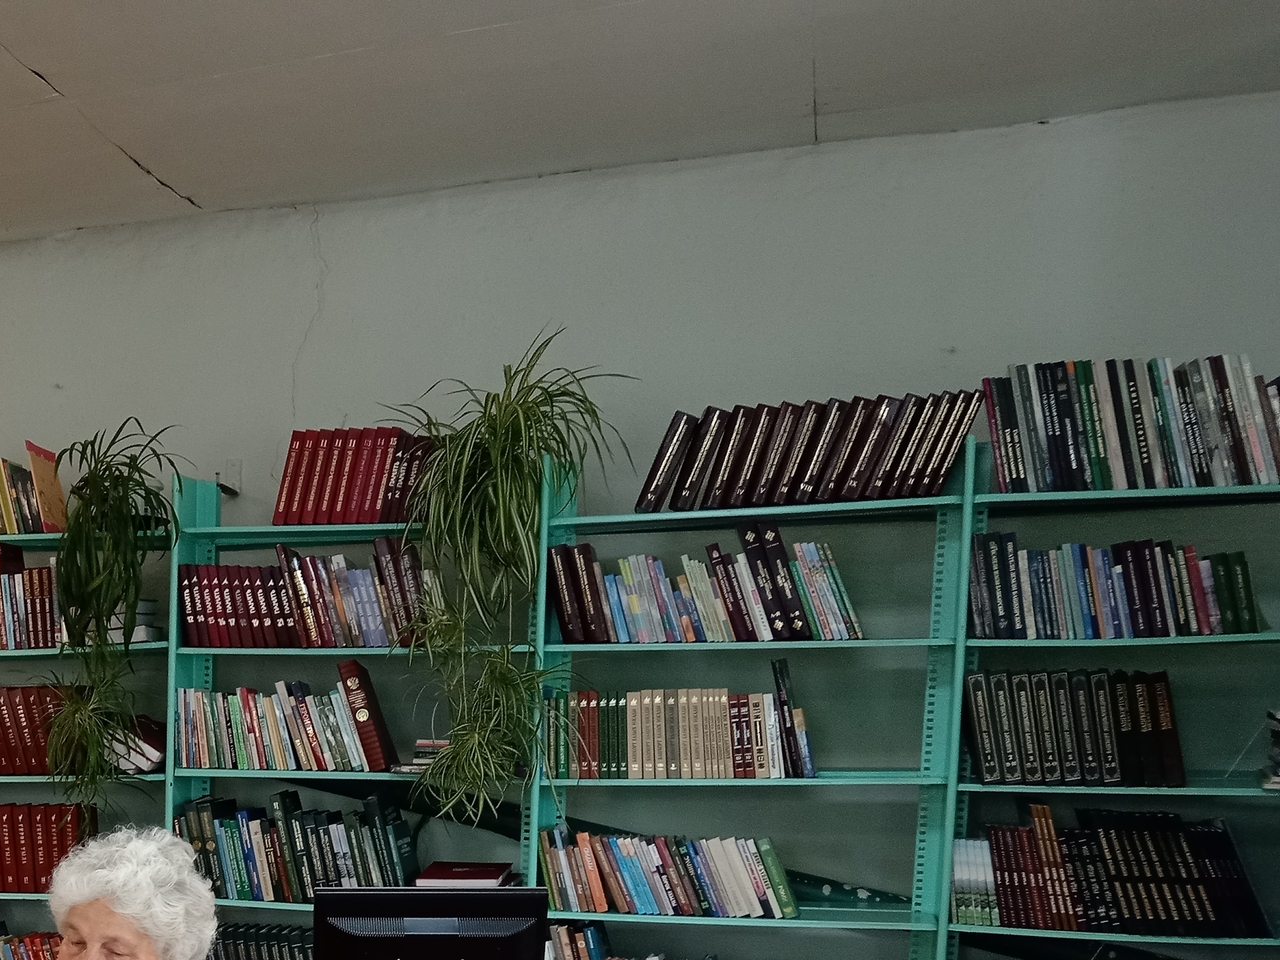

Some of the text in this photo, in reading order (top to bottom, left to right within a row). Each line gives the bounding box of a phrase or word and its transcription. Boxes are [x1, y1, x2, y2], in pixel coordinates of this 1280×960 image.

[389, 461, 399, 486] ПАМЯТЬ
[397, 462, 407, 488] ПАМЯТЬ
[194, 585, 202, 610] ПАМЯТЬ
[214, 588, 222, 613] ПАМЯТЬ
[224, 588, 232, 613] ПАМЯТЬ
[246, 588, 255, 614] ПАМЯТЬ
[257, 588, 267, 614] ПАМЯТЬ
[270, 588, 280, 614] ПАМЯТЬ
[281, 588, 289, 613] ПАМЯТЬ
